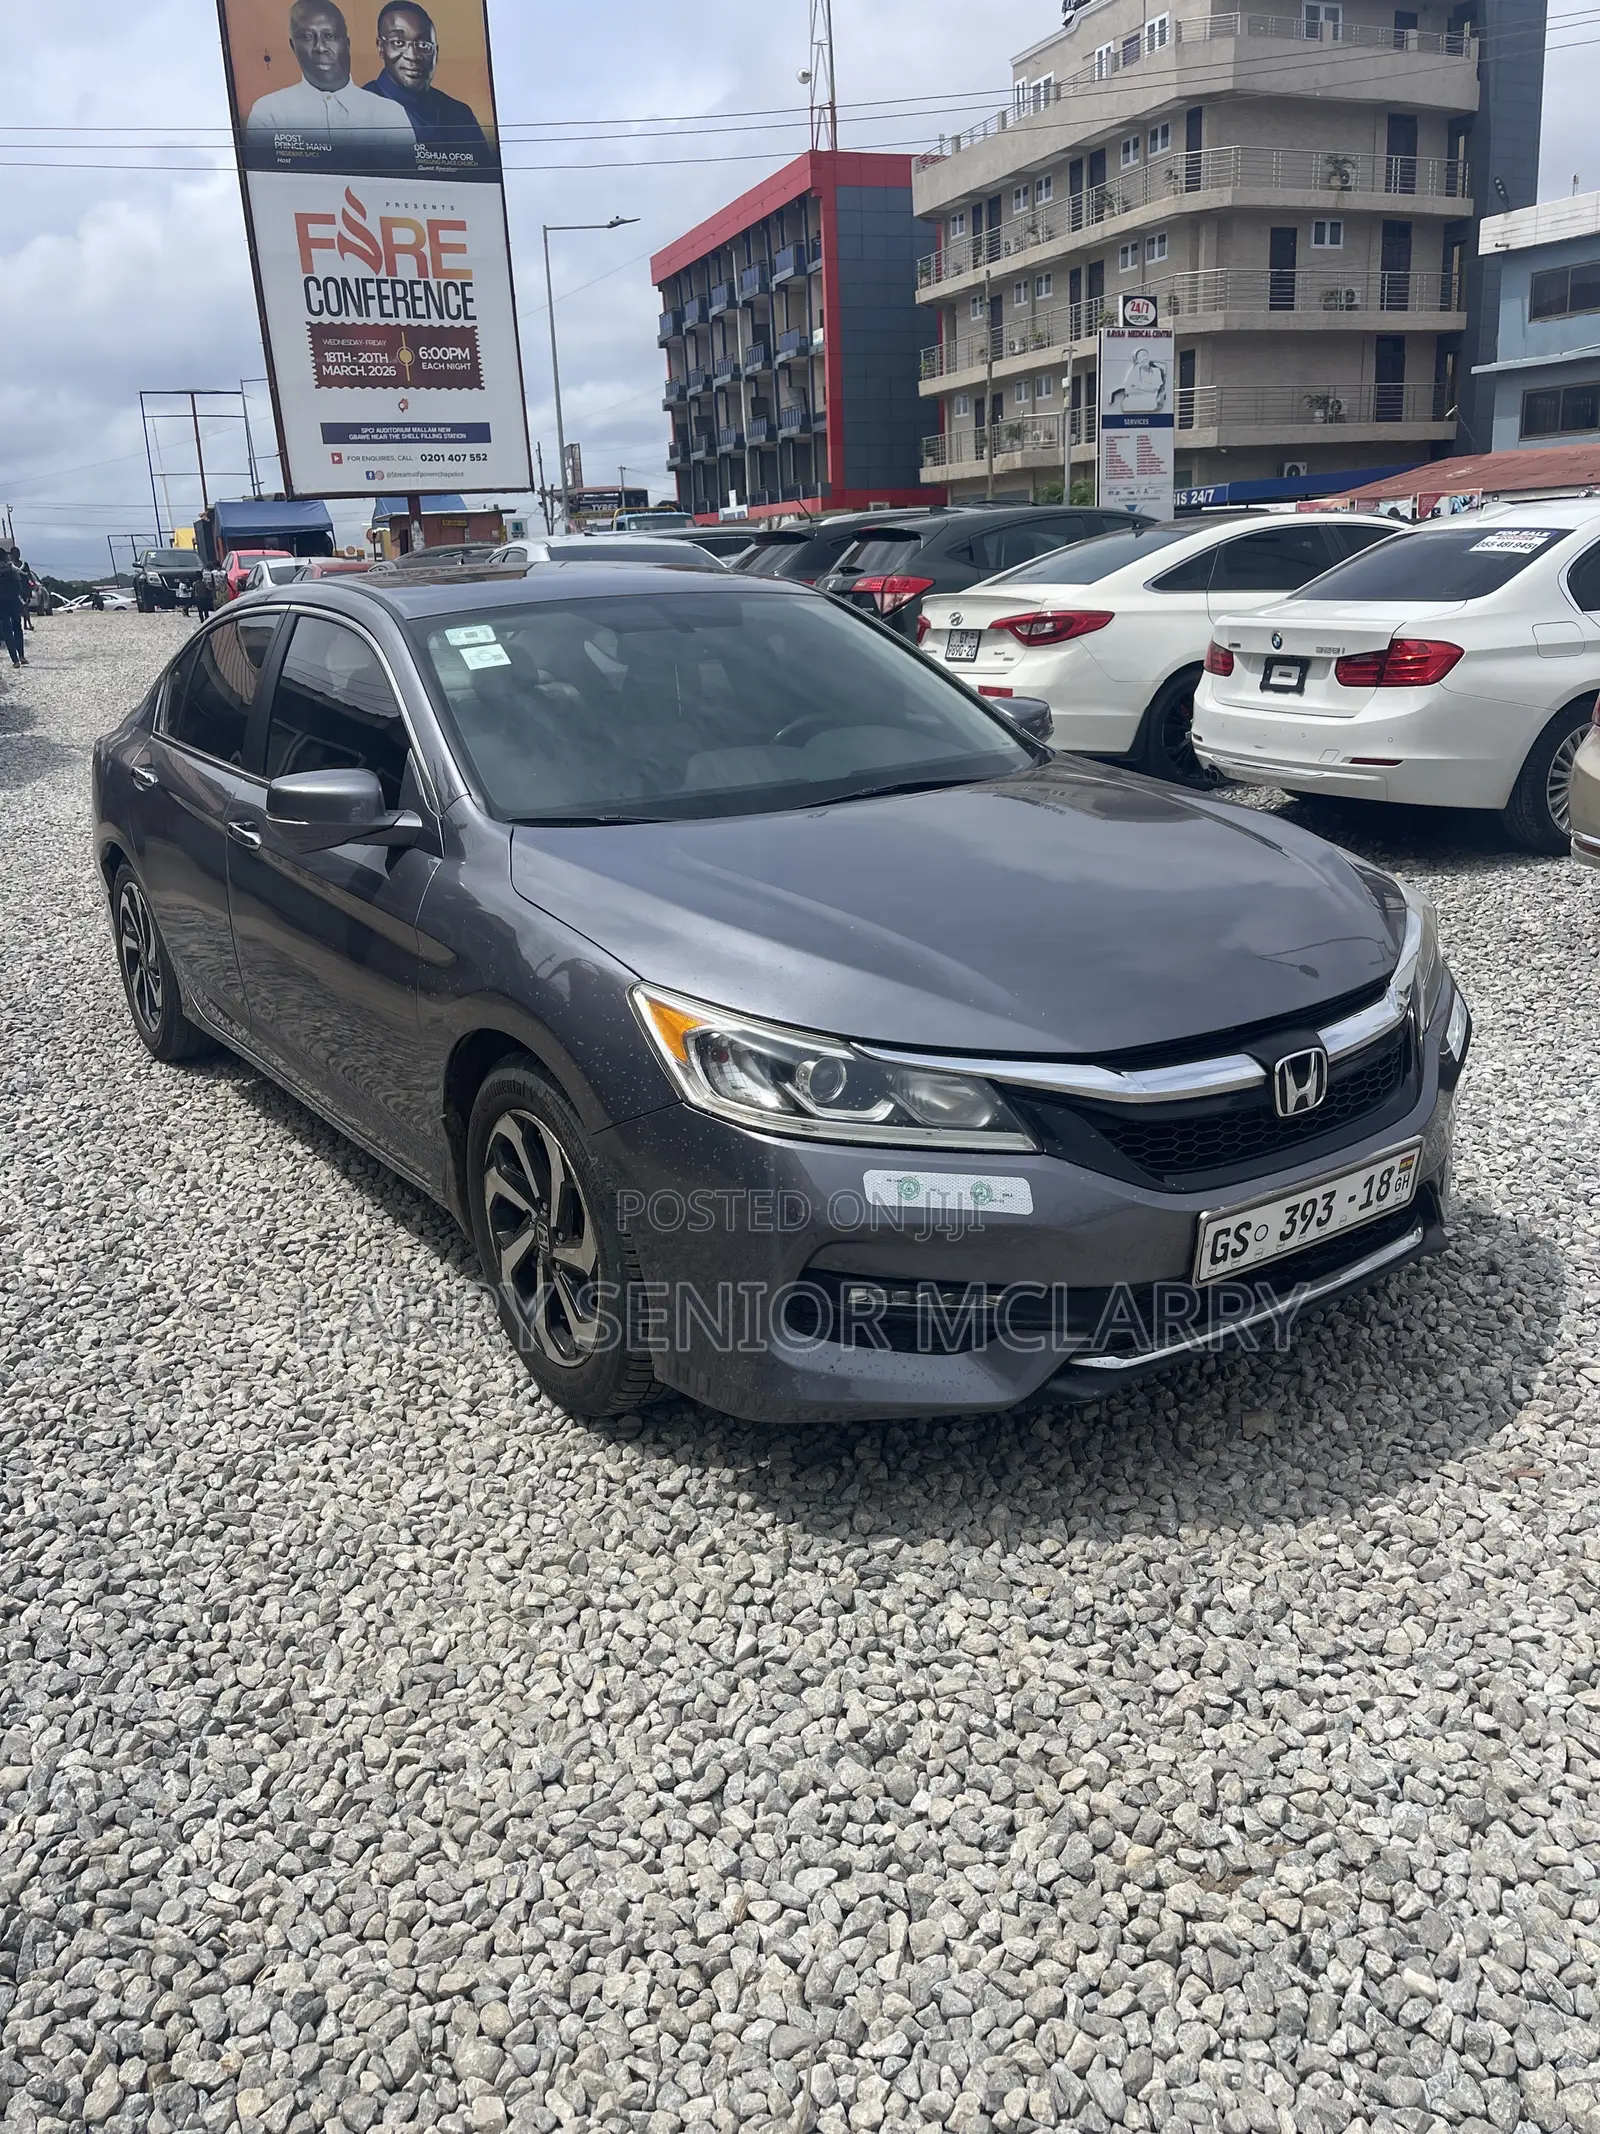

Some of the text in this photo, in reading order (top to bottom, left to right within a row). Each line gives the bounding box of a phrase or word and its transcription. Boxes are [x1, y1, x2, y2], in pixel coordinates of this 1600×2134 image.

[274, 142, 332, 151] PRINCE MANU
[413, 143, 427, 151] DR.
[415, 151, 474, 161] JOSHUA OFORI
[385, 201, 455, 211] PRESENTS
[303, 275, 477, 321] CONFERENCE
[1130, 300, 1150, 314] 24/7
[1128, 330, 1151, 338] MEDICAL
[1152, 330, 1173, 338] CENTRE
[324, 351, 352, 363] 18TH
[358, 352, 389, 363] 20TH
[418, 346, 471, 361] 6:00PM
[369, 366, 397, 376] 2026
[421, 362, 472, 371] EACH NIGHT
[420, 453, 446, 462] 0201
[447, 453, 467, 462] 407
[469, 453, 488, 461] 552
[1190, 489, 1215, 505] 24/7
[591, 503, 619, 511] TYRES
[1394, 1171, 1411, 1193] GH
[1209, 1221, 1252, 1266] GS
[1279, 1189, 1337, 1242] 393
